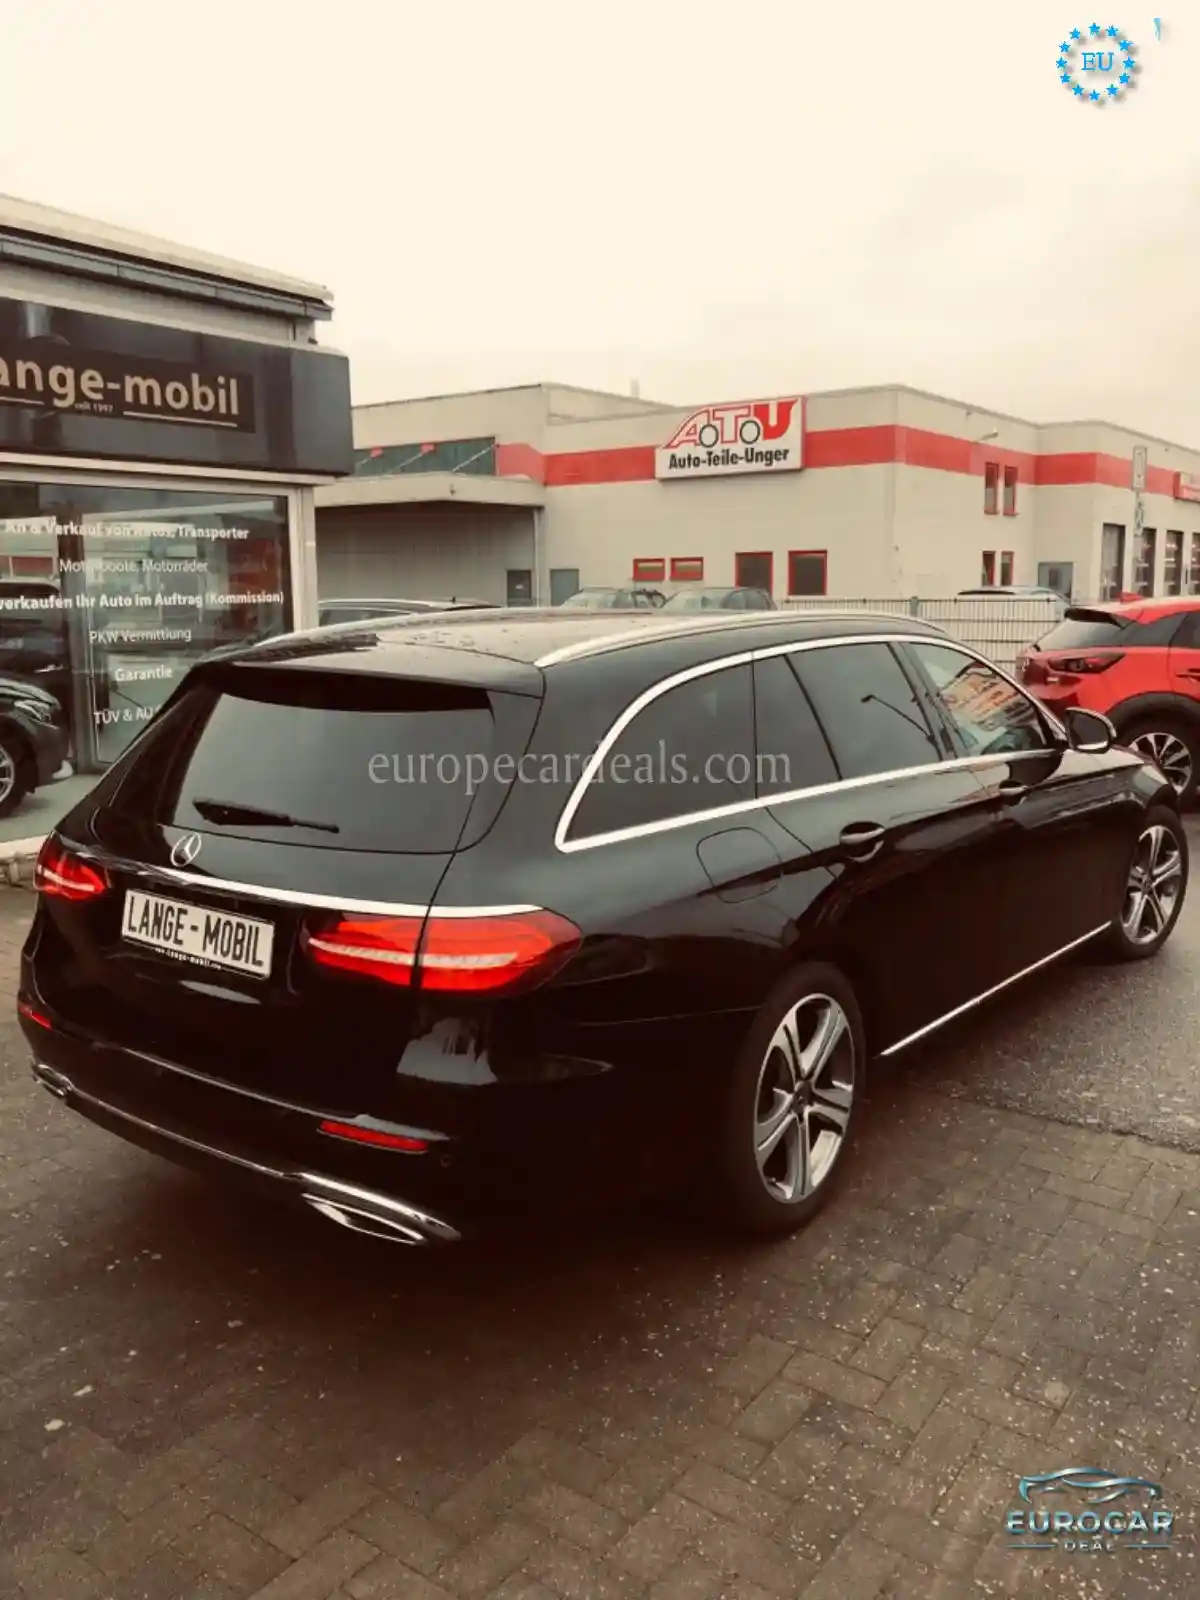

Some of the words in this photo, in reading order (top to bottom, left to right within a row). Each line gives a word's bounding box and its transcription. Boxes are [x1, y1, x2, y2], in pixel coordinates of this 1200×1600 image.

[668, 447, 790, 470] Auto-Teile-Unger
[178, 525, 249, 541] Transporter
[76, 591, 96, 608] Ihr
[100, 593, 132, 608] Auto
[135, 593, 152, 607] im
[155, 591, 203, 609] Auftrag
[205, 589, 284, 605] (Kommission)
[89, 629, 118, 644] PKW
[120, 627, 192, 643] Vermittlung
[115, 664, 173, 682] Garantie
[123, 707, 133, 722] &
